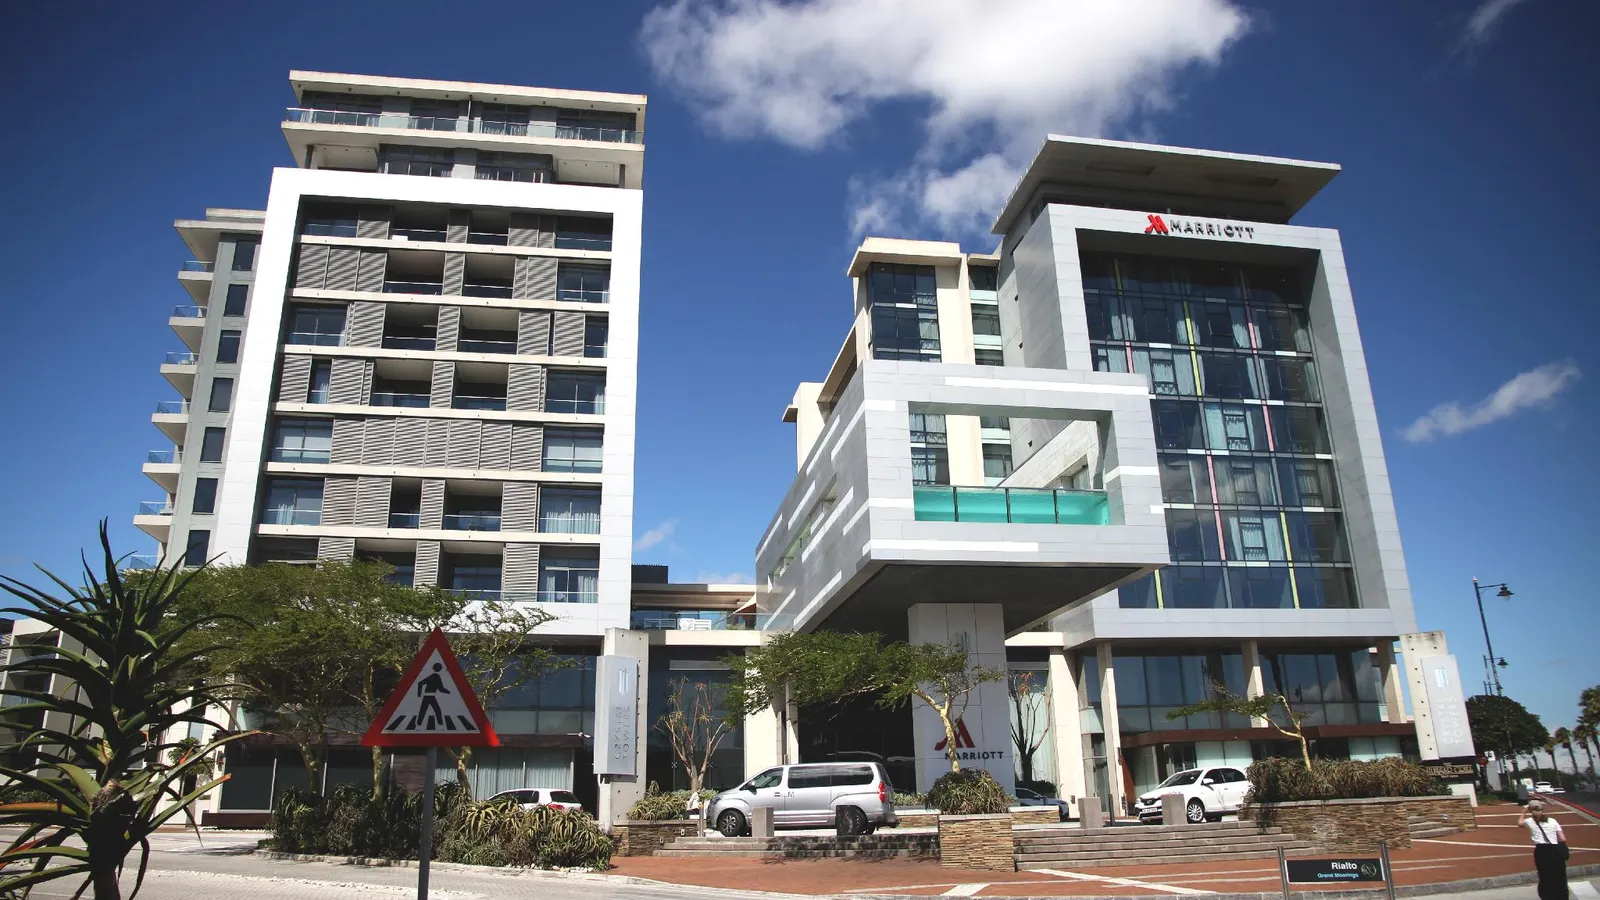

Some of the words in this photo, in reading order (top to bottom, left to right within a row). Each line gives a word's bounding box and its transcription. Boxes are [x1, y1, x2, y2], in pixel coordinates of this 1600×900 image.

[1169, 219, 1255, 240] MARRIOTT
[1331, 861, 1358, 870] Rialto
[1334, 872, 1360, 880] Moorings
